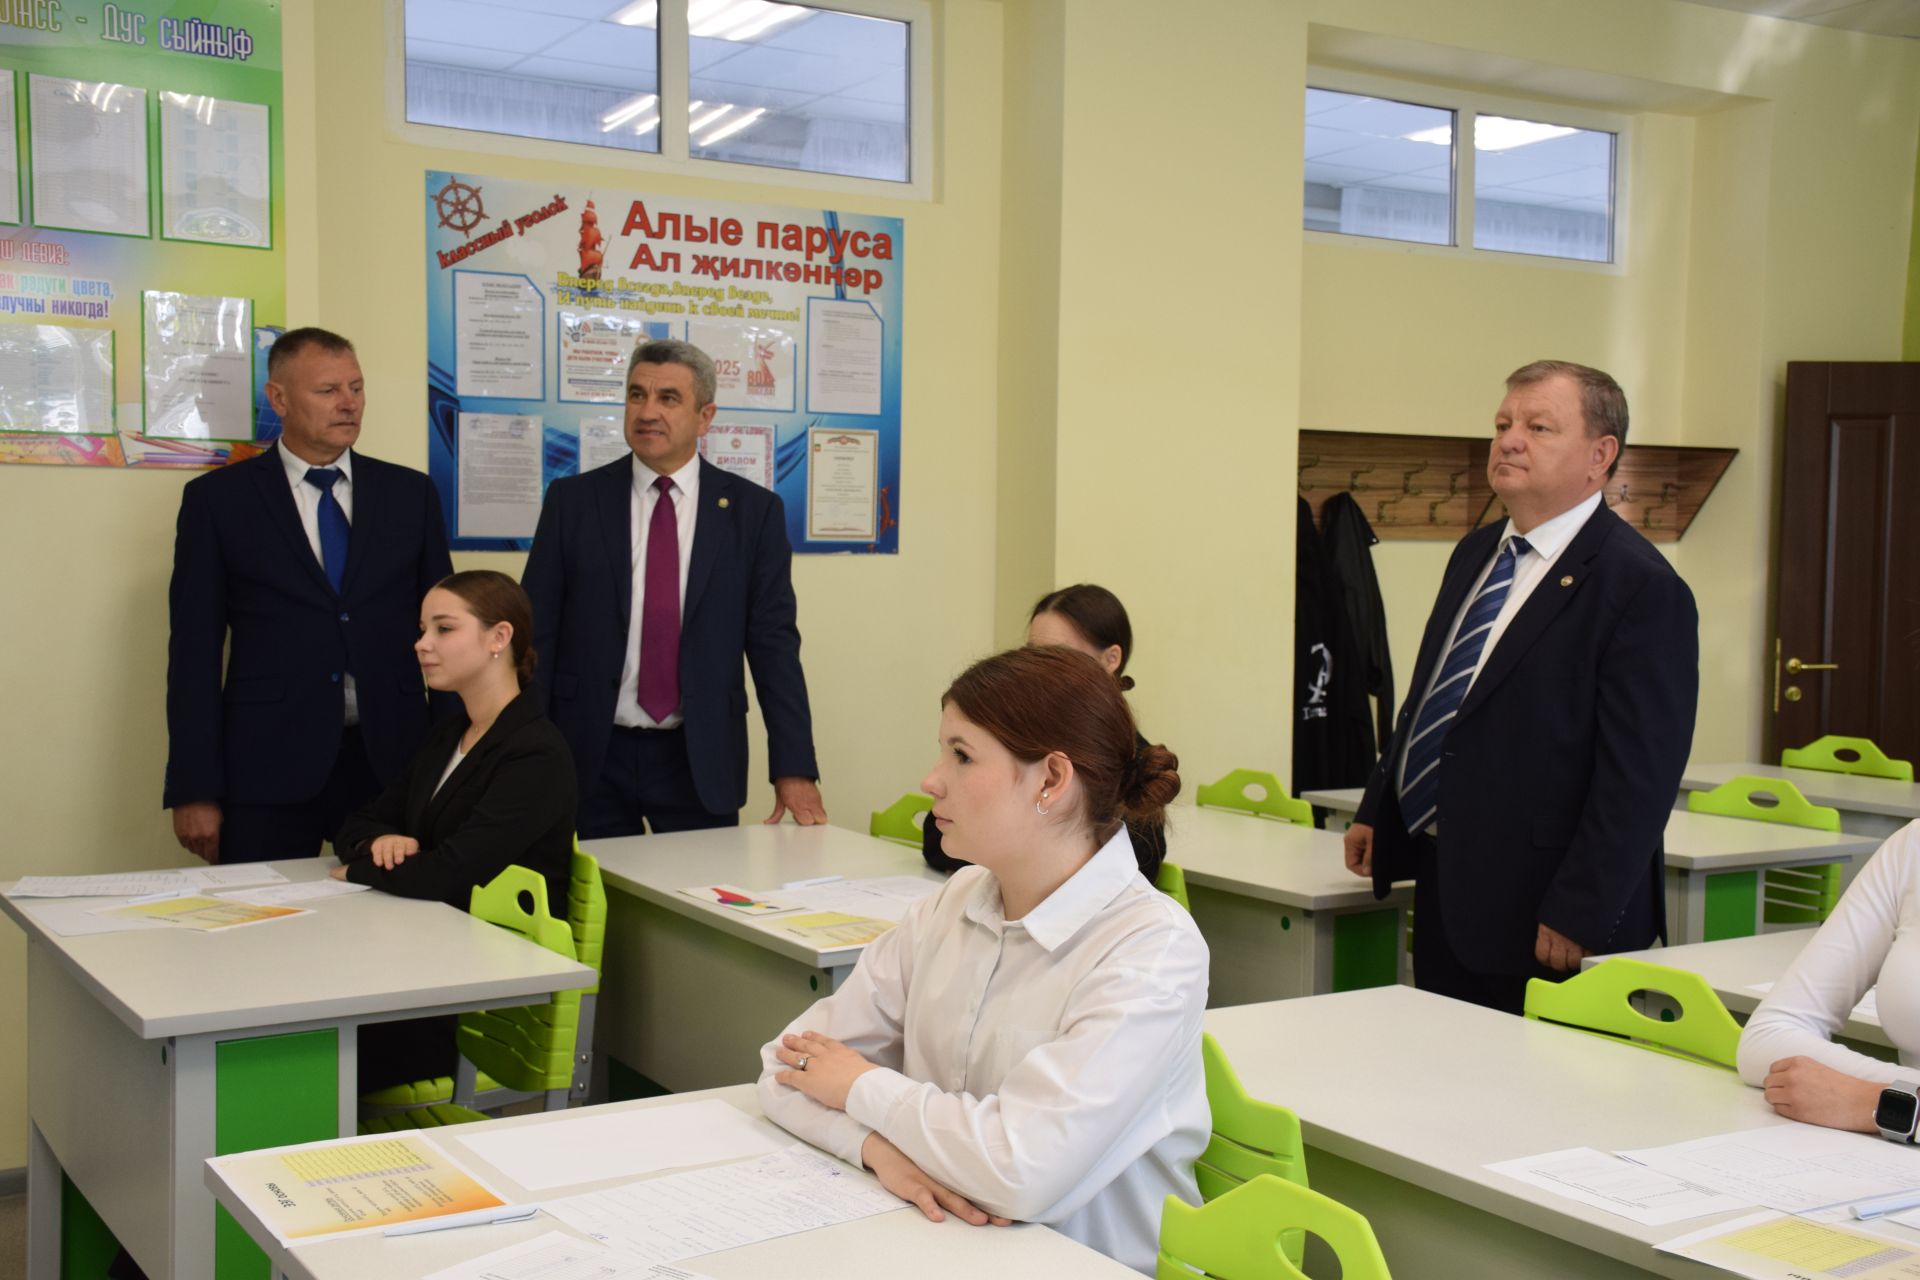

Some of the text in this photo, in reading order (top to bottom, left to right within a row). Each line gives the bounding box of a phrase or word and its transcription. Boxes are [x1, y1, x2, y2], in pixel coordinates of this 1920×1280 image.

[621, 200, 893, 263] Алые паруса
[629, 243, 681, 273] Ал
[21, 275, 66, 295] радуги
[72, 279, 115, 300] цвета,
[0, 295, 109, 319] лучны никогда!
[557, 290, 571, 305] И
[575, 294, 616, 311] путь
[716, 455, 757, 465] ДИПЛОМ
